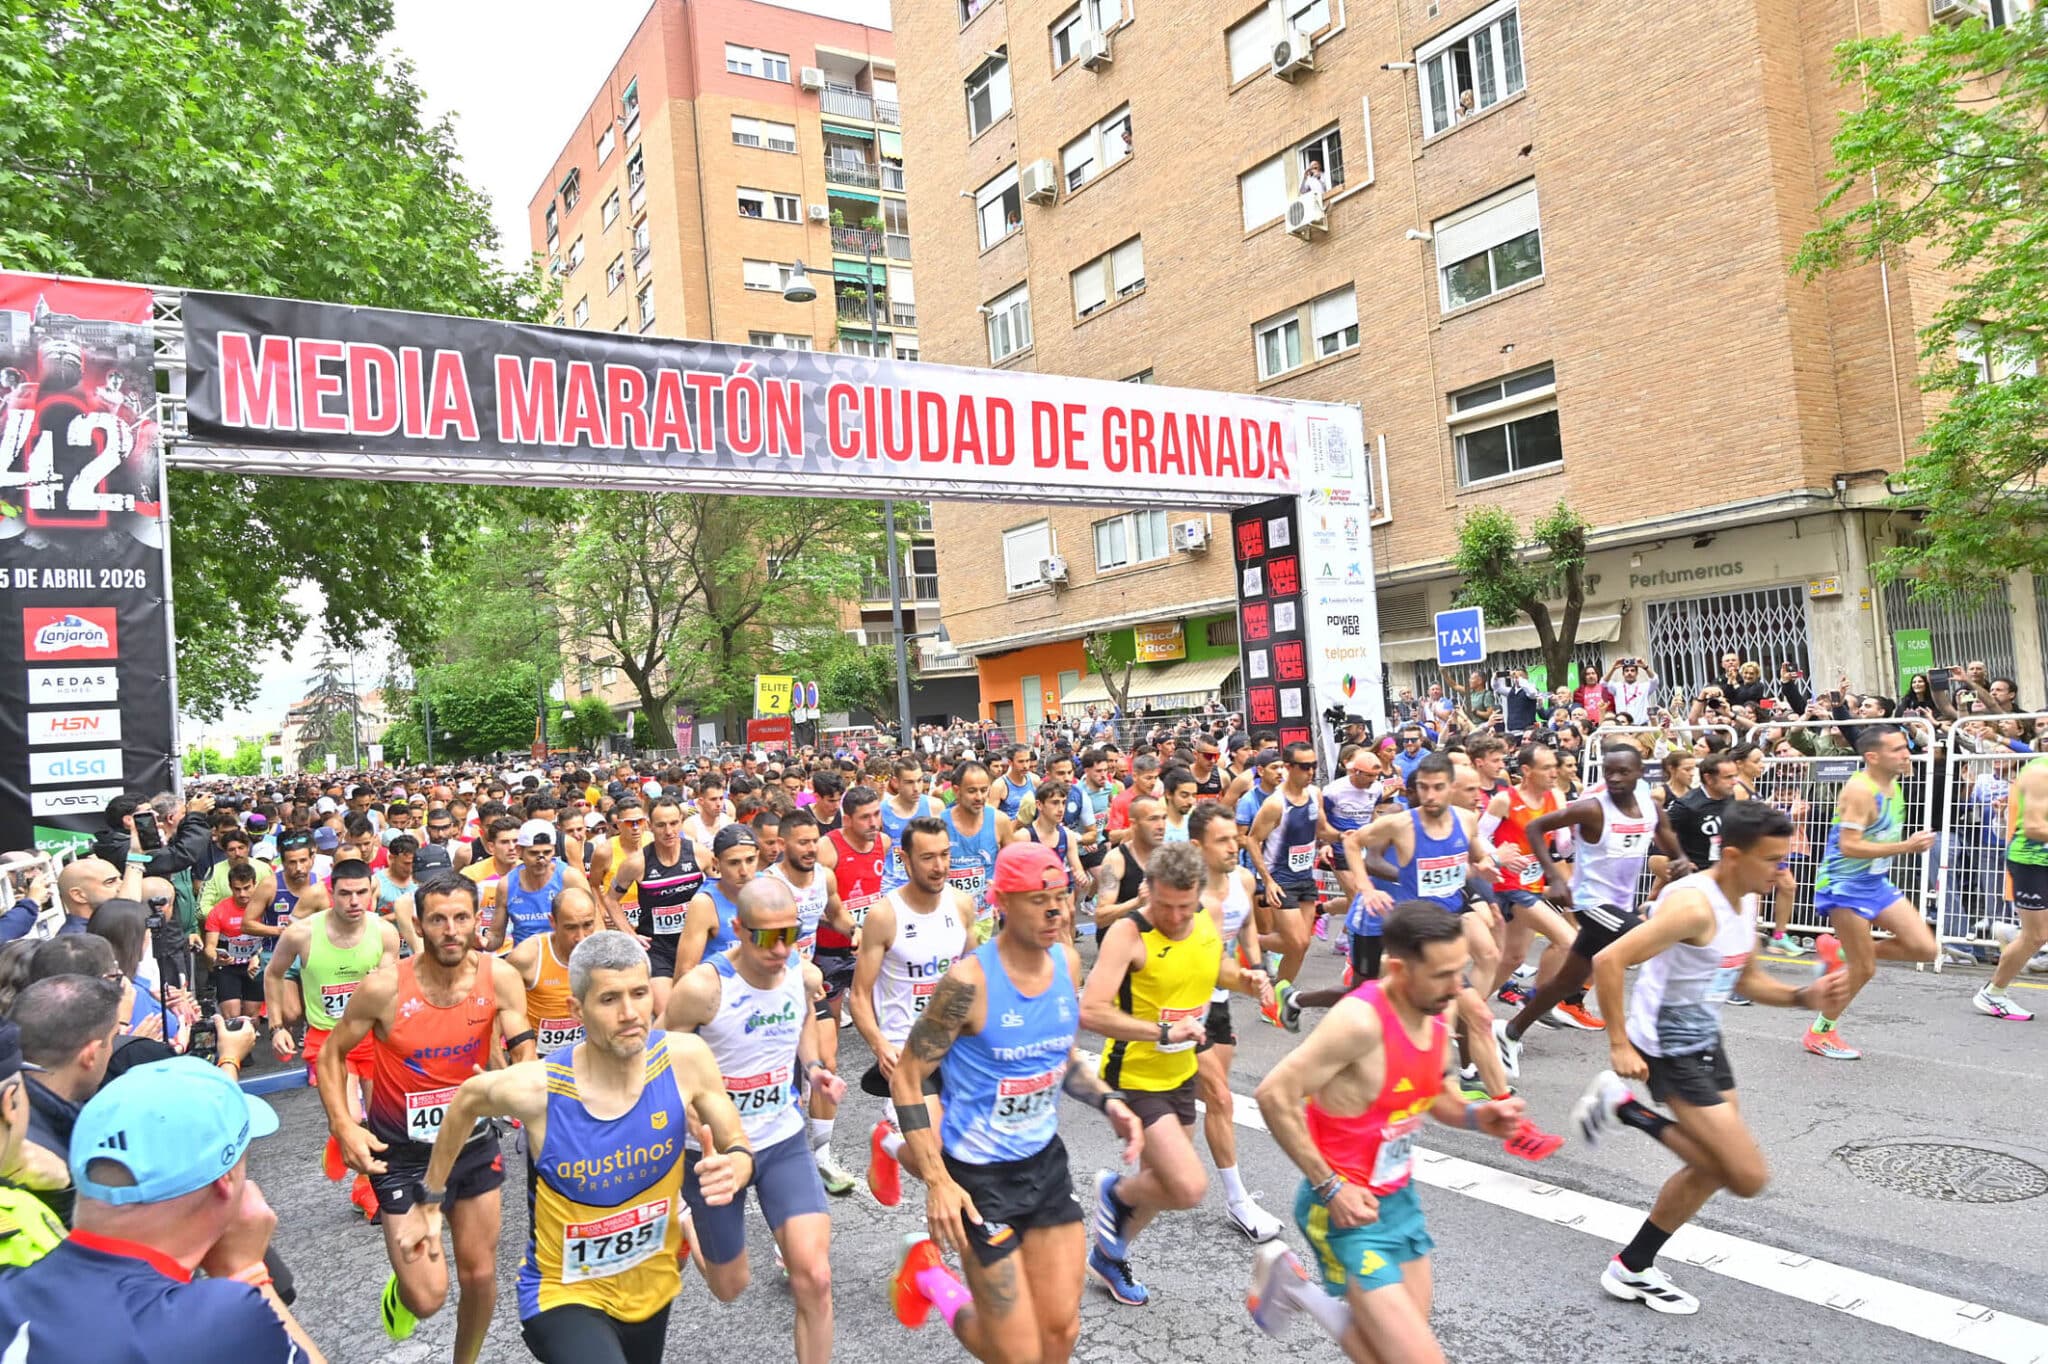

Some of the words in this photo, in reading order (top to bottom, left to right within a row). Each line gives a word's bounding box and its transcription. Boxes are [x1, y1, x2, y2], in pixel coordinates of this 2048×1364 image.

[217, 331, 480, 441] MEDIA
[494, 354, 806, 459] MARATÓN
[827, 382, 1015, 468] CIUDAD
[1031, 400, 1089, 471] DE
[1102, 406, 1291, 480] GRANADA
[0, 408, 136, 512] 42
[15, 568, 38, 589] DE
[42, 568, 96, 588] ABRIL
[100, 568, 146, 588] 2026
[1327, 615, 1360, 626] POWER
[40, 628, 103, 645] Lanjarón
[1342, 625, 1360, 636] ADE
[1439, 626, 1479, 648] TAXI
[1145, 644, 1176, 653] RICO
[41, 676, 106, 687] AEDAS
[760, 683, 789, 692] ELITE
[770, 695, 780, 708] 2
[51, 716, 100, 731] HSN
[48, 758, 106, 777] alsa
[45, 795, 100, 807] LASER
[1623, 834, 1641, 848] 57
[541, 1026, 585, 1045] 3945
[413, 1036, 481, 1059] atracón
[557, 1138, 673, 1184] agustinos
[578, 1166, 659, 1192] GRANADA
[571, 1222, 654, 1263] 1785
